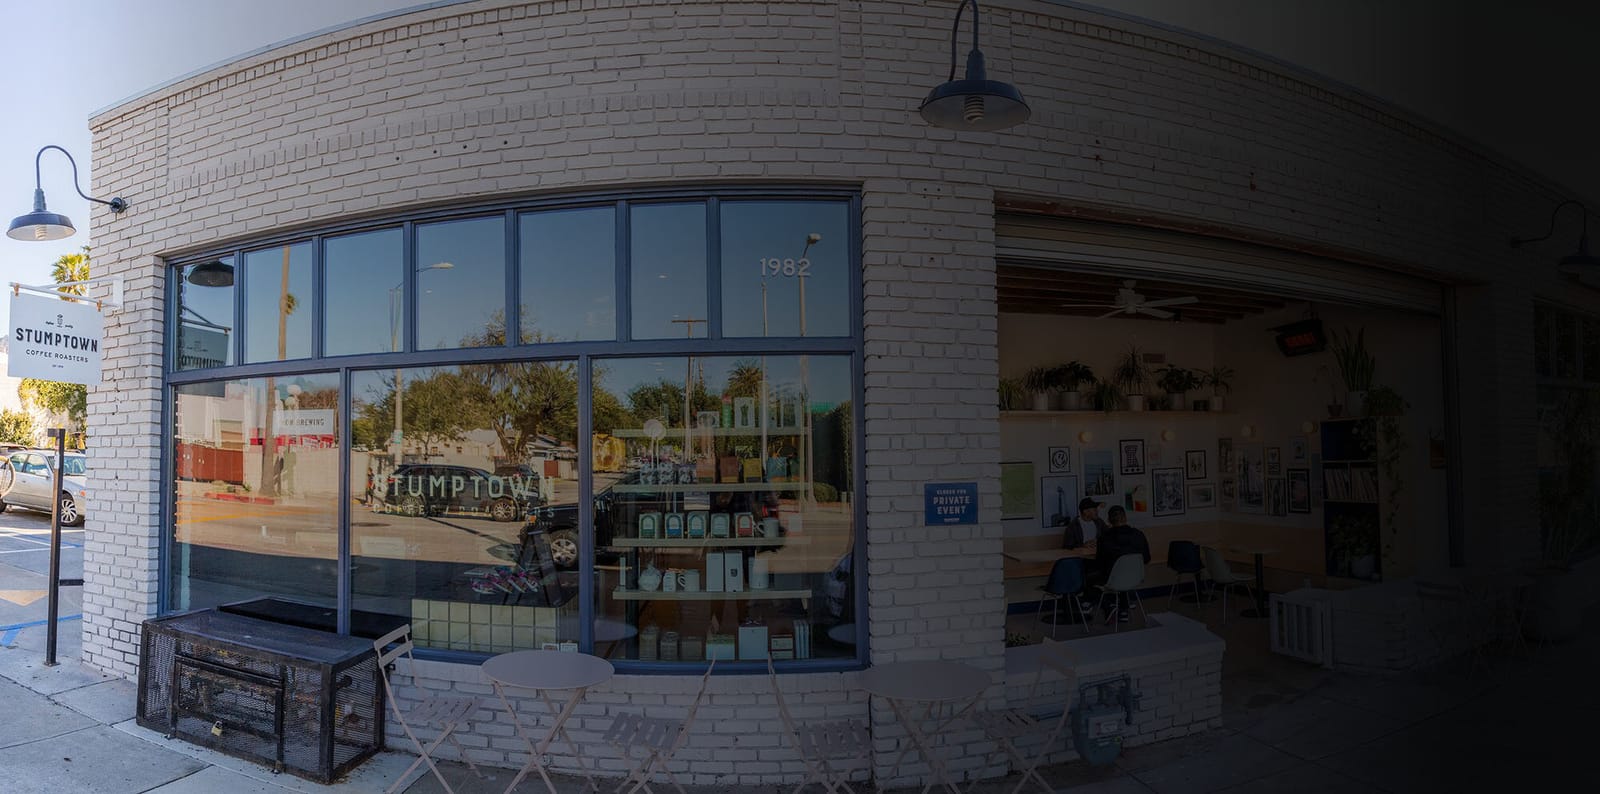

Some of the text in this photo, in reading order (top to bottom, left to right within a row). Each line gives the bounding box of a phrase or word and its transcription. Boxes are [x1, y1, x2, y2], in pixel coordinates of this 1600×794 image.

[759, 258, 811, 277] 1982
[16, 327, 98, 353] STUMPTOWN
[26, 349, 89, 363] COFFEE ROASTERS
[372, 473, 555, 501] STUMPTOWN
[933, 495, 970, 505] PRIVATE
[936, 505, 966, 515] EVENT
